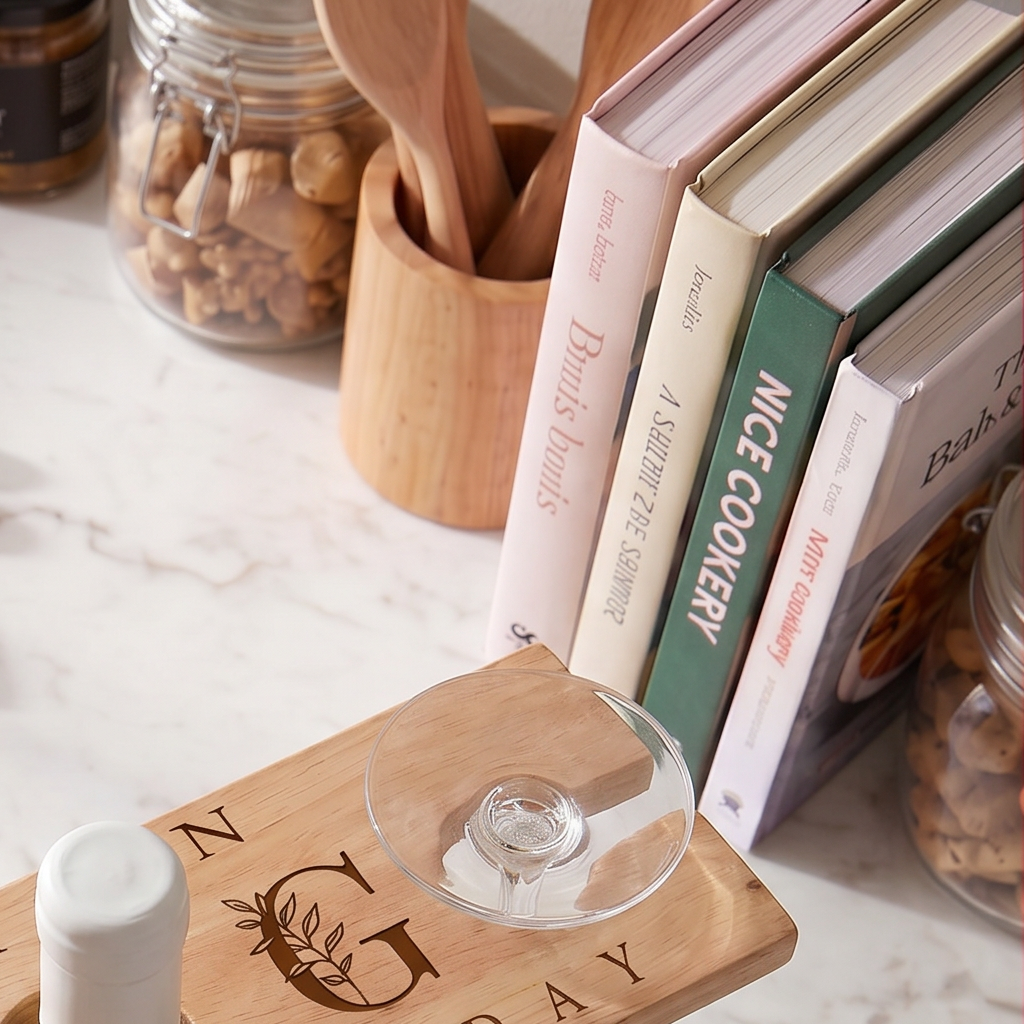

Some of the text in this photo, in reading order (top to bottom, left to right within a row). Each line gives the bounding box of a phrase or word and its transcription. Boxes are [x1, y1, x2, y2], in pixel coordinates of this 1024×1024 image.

[736, 369, 793, 474] NICE
[687, 468, 763, 646] COOKERY
[260, 850, 442, 1013] G
